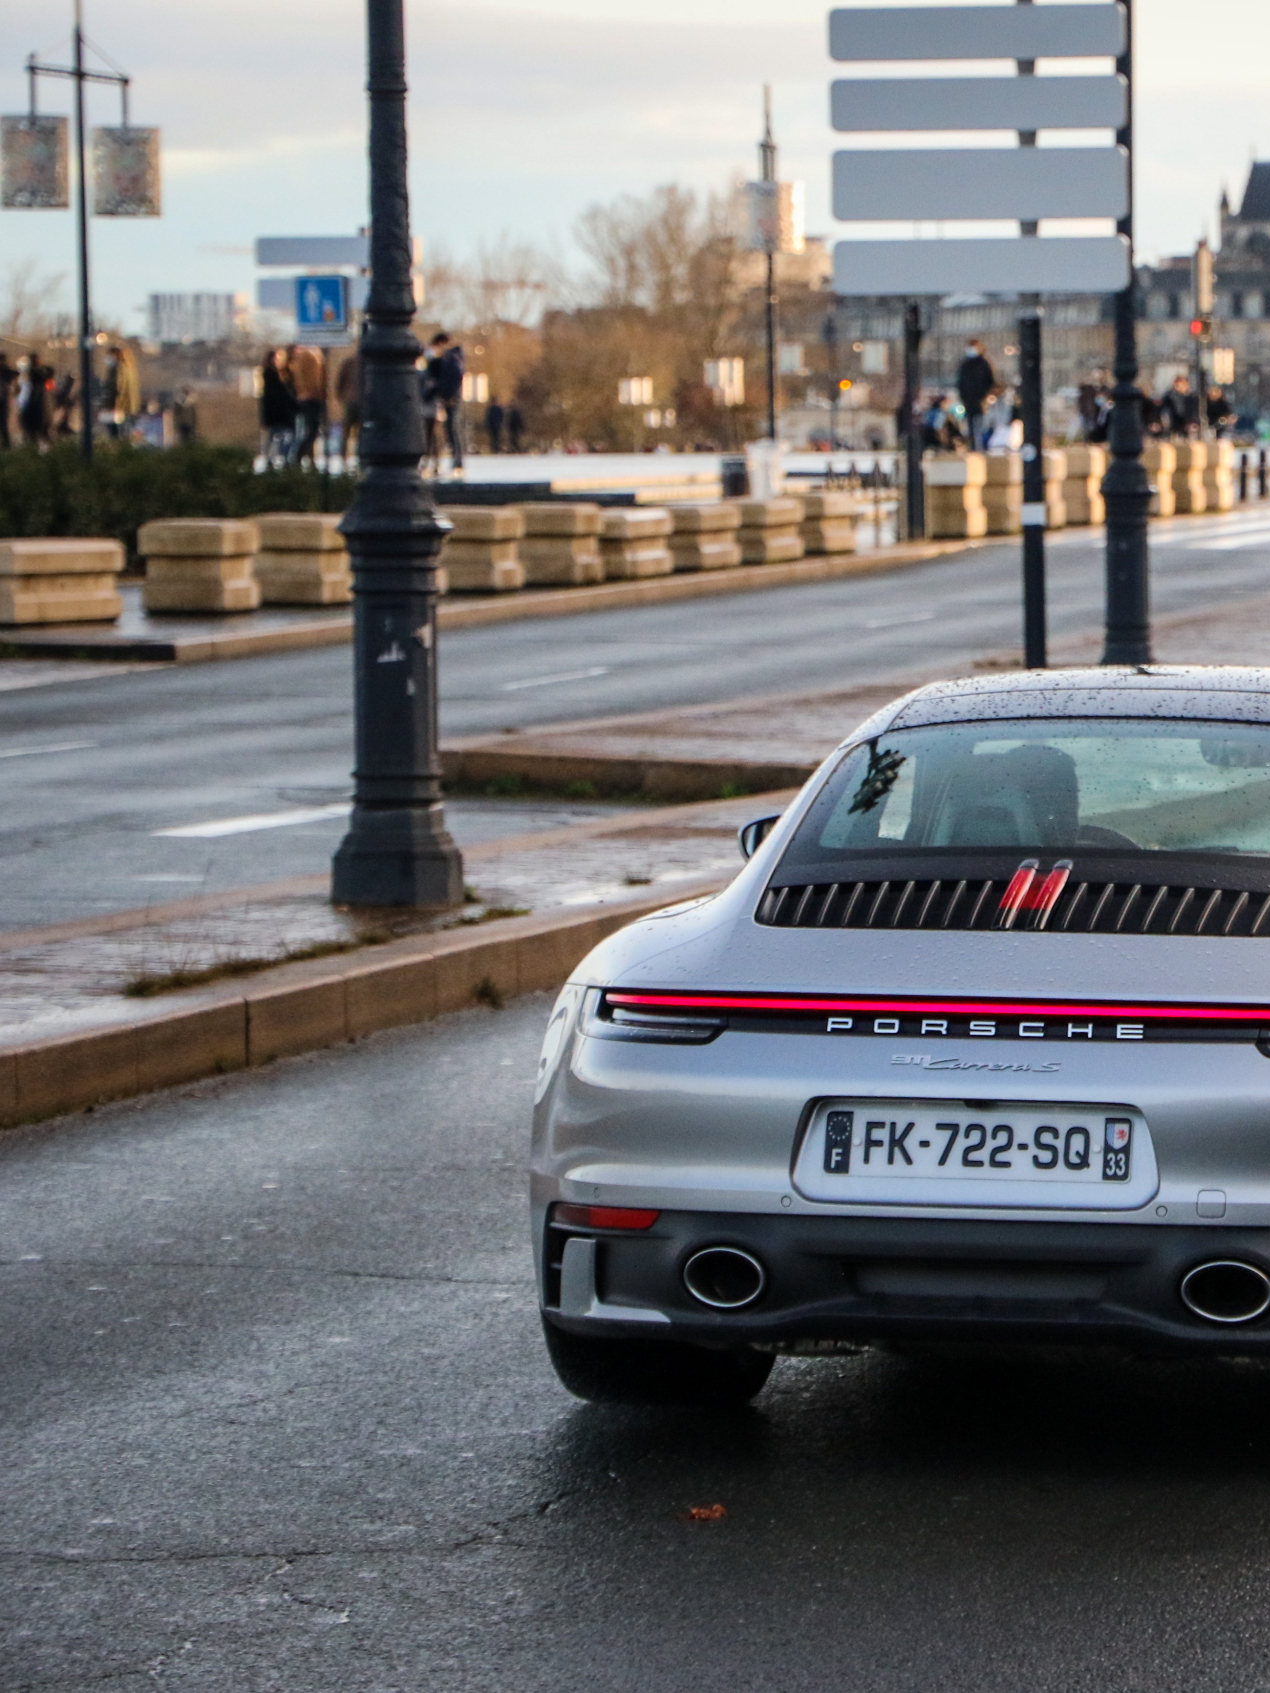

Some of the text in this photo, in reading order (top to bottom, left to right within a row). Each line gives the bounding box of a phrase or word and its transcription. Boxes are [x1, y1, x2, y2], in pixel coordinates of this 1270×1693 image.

[827, 1018, 1144, 1039] PORSCHE
[891, 1053, 1062, 1073] 911 Carrera S
[863, 1121, 1091, 1171] FK-722-SQ
[829, 1149, 844, 1169] F
[1105, 1153, 1126, 1176] 33
